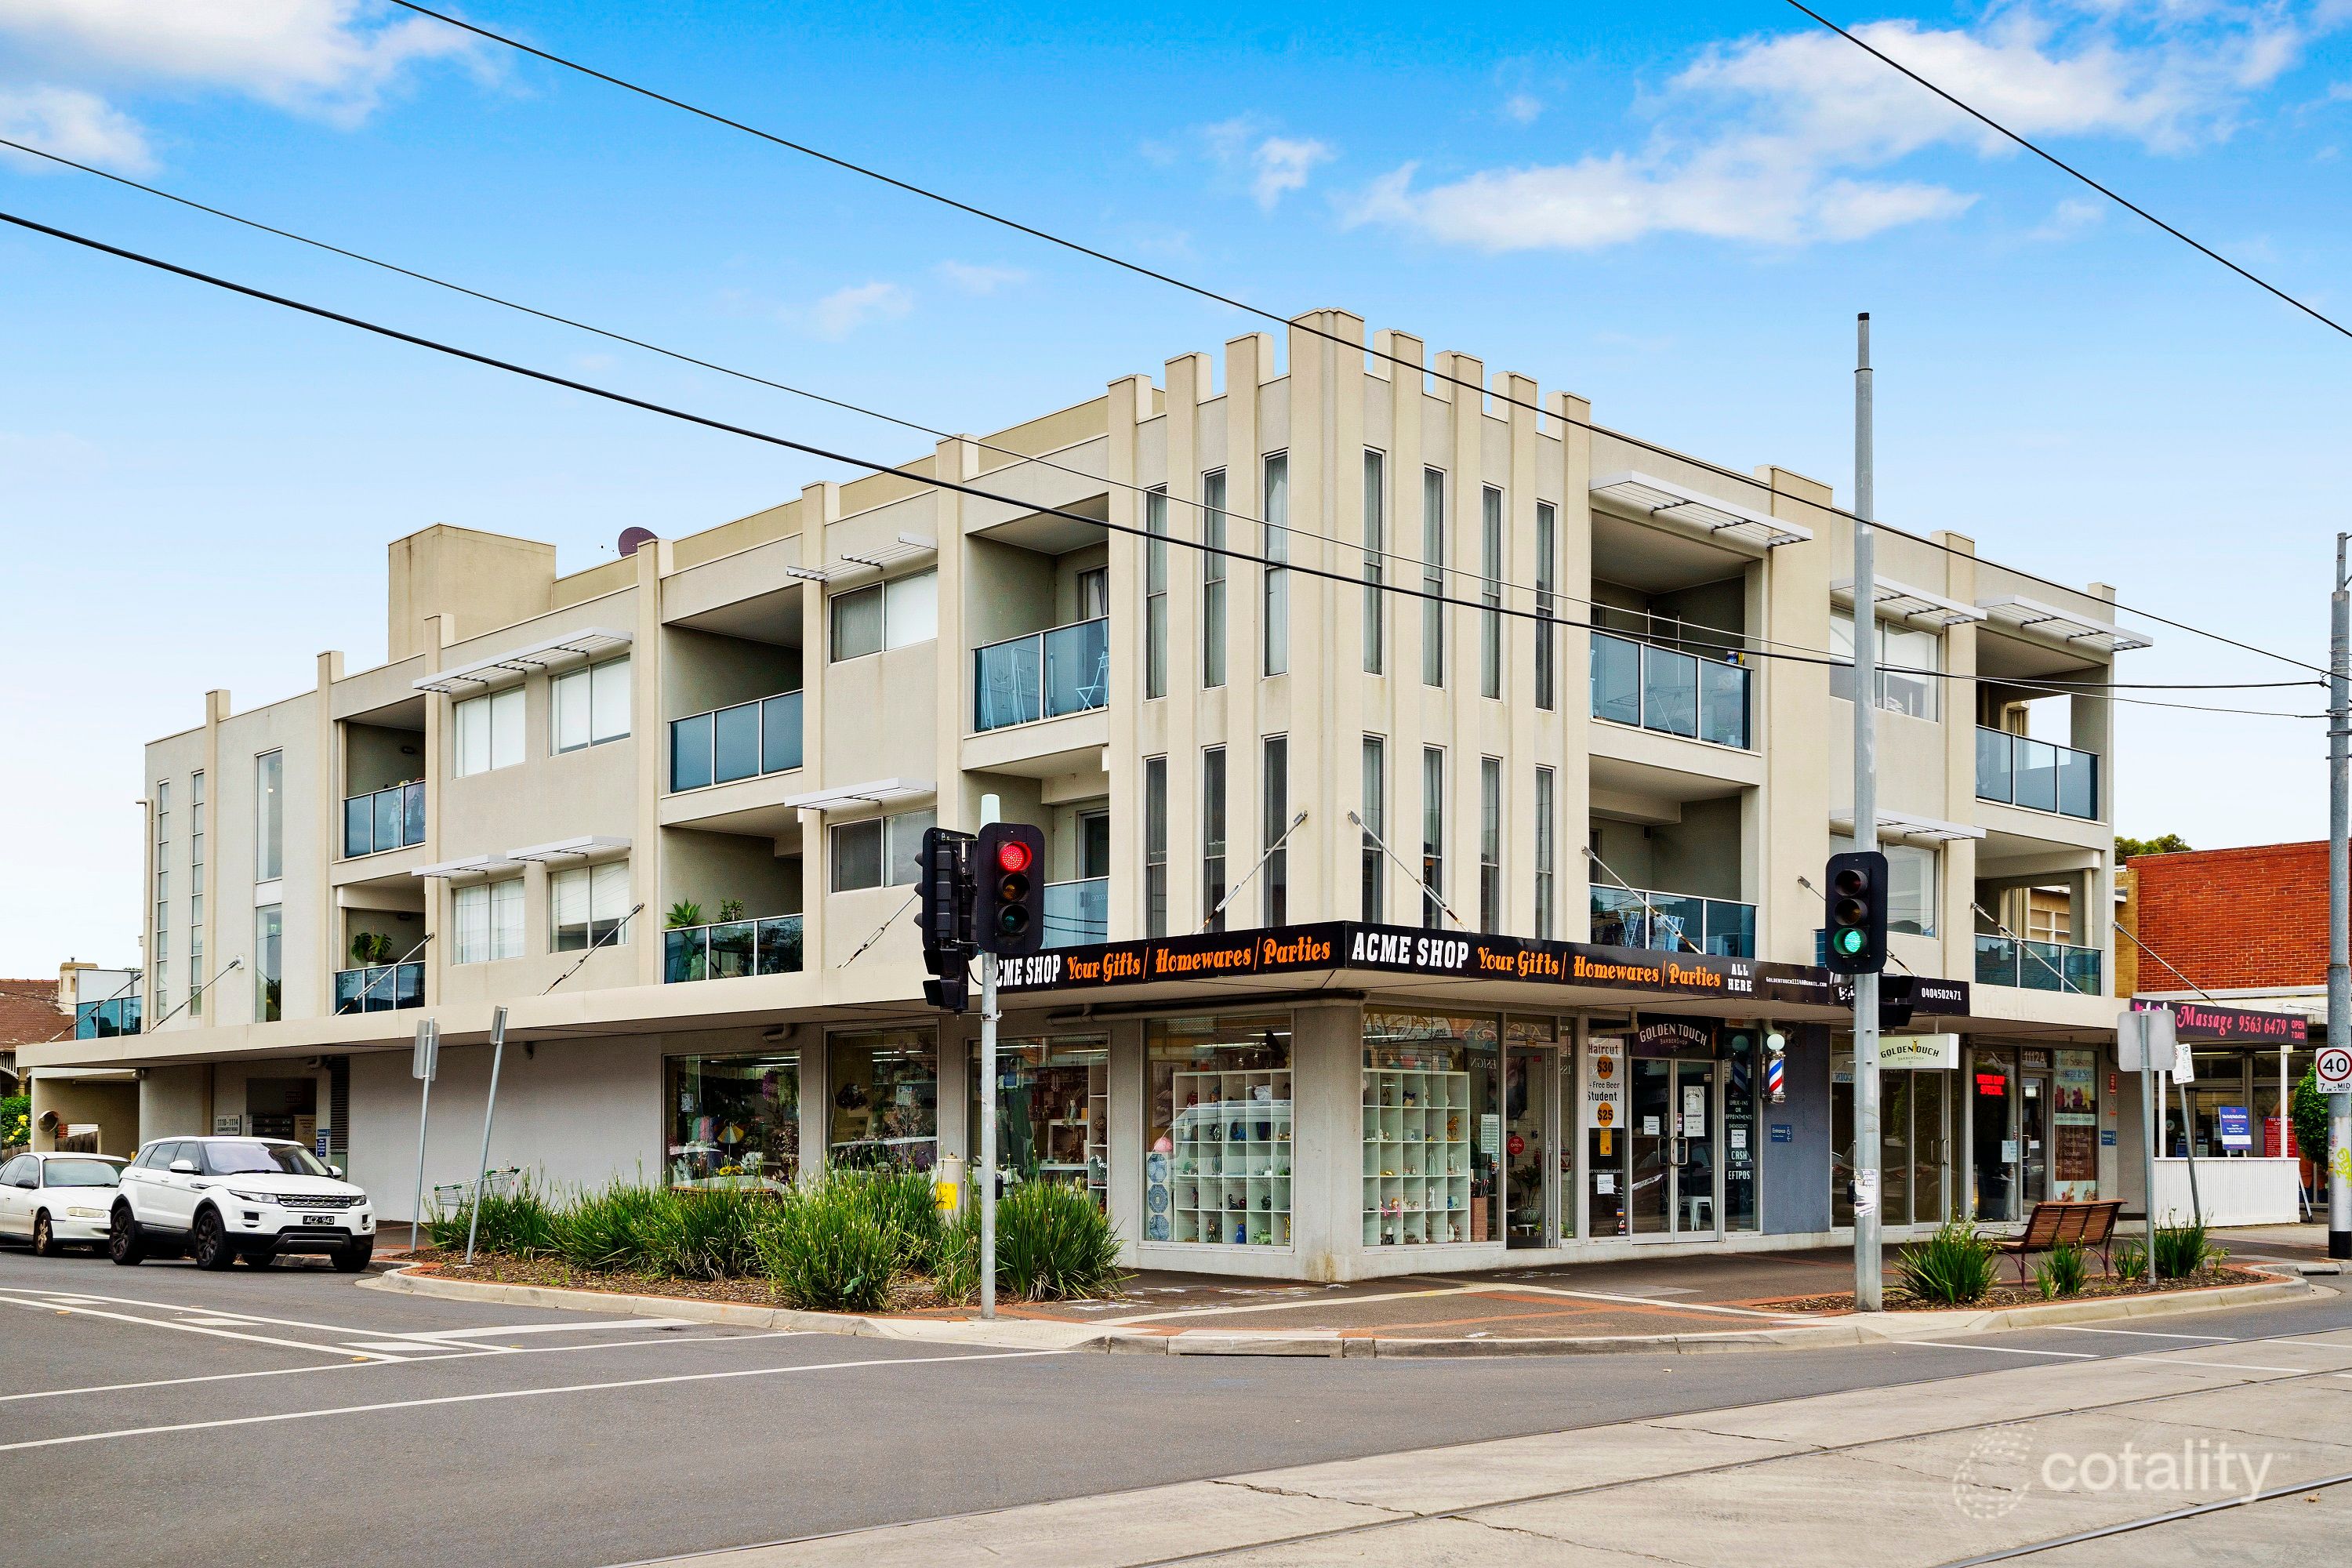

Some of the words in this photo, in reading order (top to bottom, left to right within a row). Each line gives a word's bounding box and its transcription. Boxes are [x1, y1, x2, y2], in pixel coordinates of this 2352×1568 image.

[996, 958, 1022, 987] CME
[1025, 954, 1061, 985] SHOP
[1067, 956, 1100, 980] Your
[1102, 951, 1141, 982] Gifts
[1156, 947, 1251, 974] Homewares
[1263, 936, 1330, 965] Parties
[1352, 932, 1411, 964] ACME
[1416, 938, 1469, 969] SHOP
[1478, 946, 1514, 972] Your
[1518, 951, 1559, 977] Gifts
[1573, 955, 1659, 982] Homewares
[1668, 963, 1721, 987] Parties
[1731, 963, 1749, 977] ALL
[1727, 978, 1752, 993] HERE
[1921, 987, 1962, 1001] 0404502471
[2176, 1005, 2233, 1036] Massage
[2238, 1015, 2262, 1033] 9563
[2264, 1018, 2288, 1035] 6479
[2291, 1019, 2305, 1030] OPEN
[1639, 1023, 1676, 1043] GOLDEN
[1678, 1024, 1708, 1047] TOUCH
[2294, 1031, 2305, 1040] DAYS
[1588, 1044, 1619, 1055] Haircut
[2024, 1051, 2045, 1063] 1112A
[1597, 1061, 1613, 1073] $30
[2322, 1058, 2347, 1073] 40
[2320, 1083, 2325, 1091] 7
[1588, 1091, 1617, 1102] Student
[1597, 1108, 1613, 1122] $25
[1731, 1150, 1748, 1160] CASH
[1728, 1171, 1751, 1180] EFTPOS
